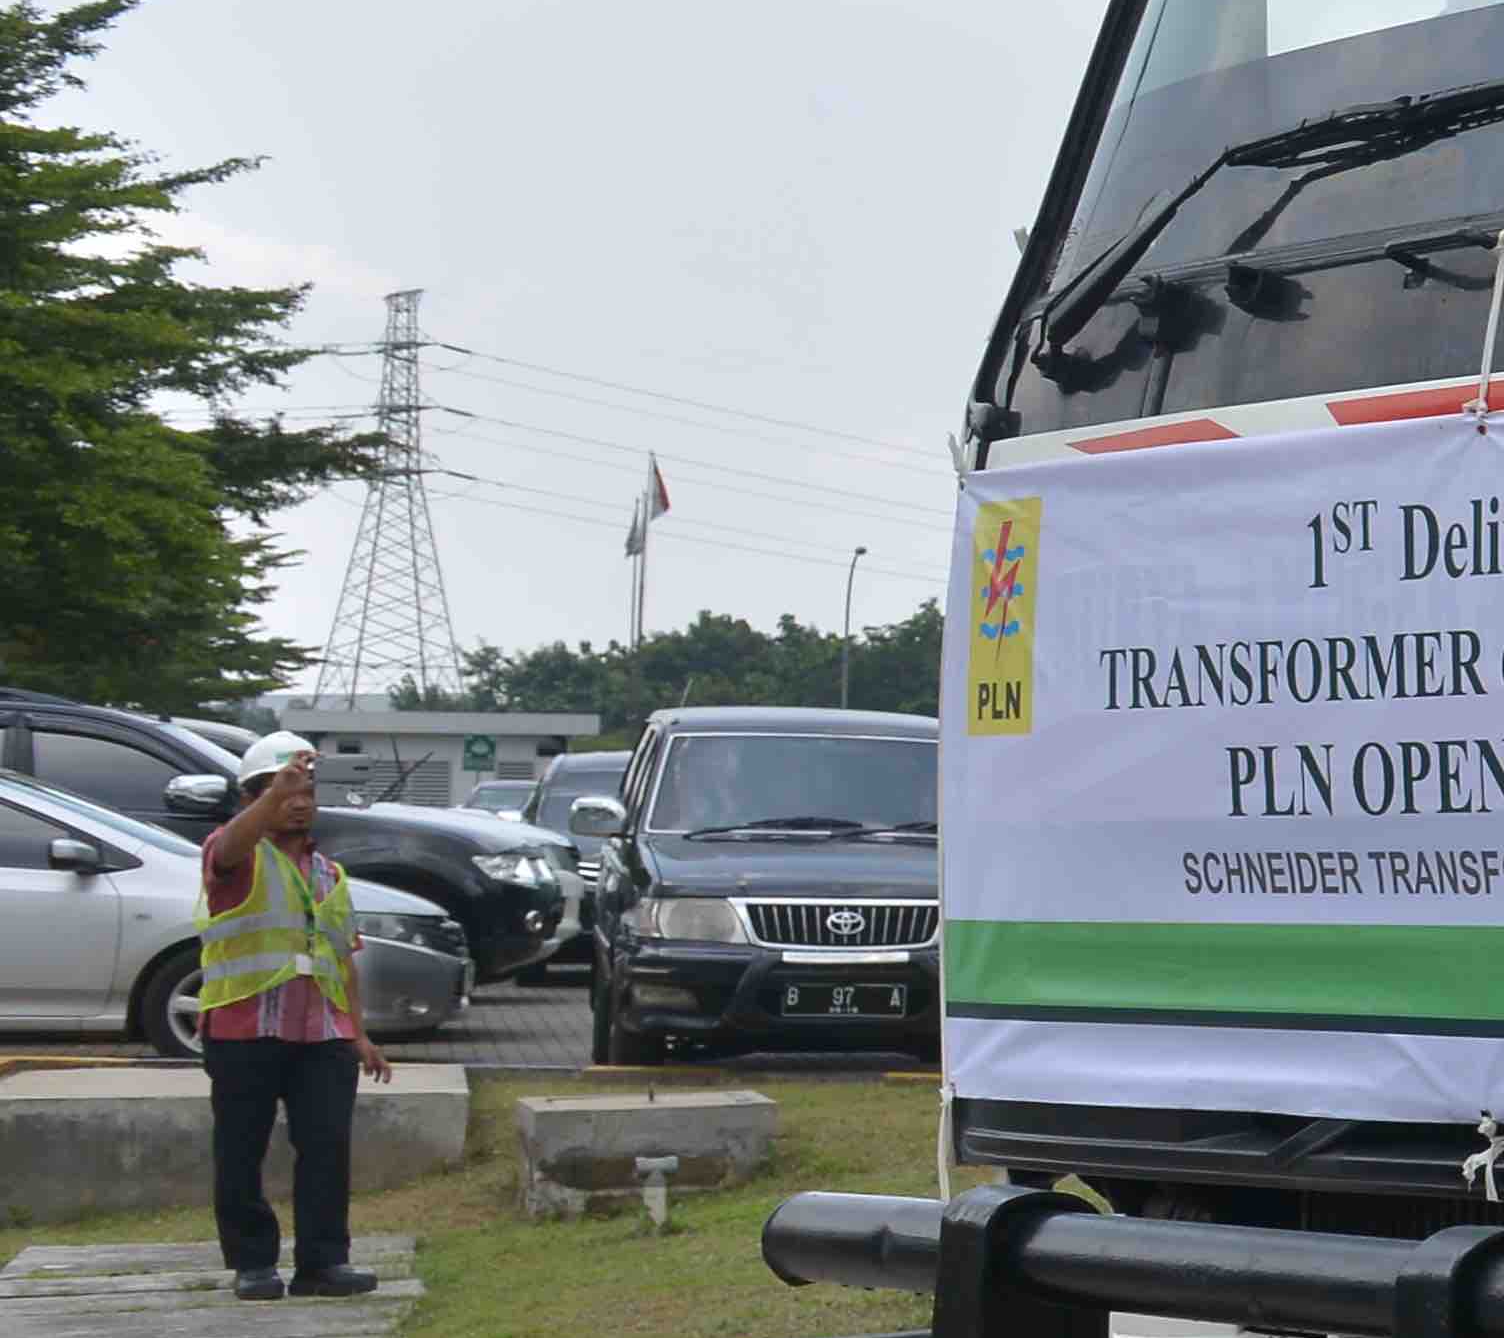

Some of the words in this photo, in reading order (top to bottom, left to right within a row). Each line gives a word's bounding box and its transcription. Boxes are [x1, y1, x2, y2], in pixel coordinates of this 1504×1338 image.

[1308, 499, 1378, 589] 1ST
[1100, 630, 1485, 710] TRANSFORMER
[976, 680, 1023, 721] PLN
[1225, 743, 1335, 818] PLN
[1183, 851, 1361, 895] SCHNEIDER
[786, 986, 799, 1006] B
[832, 986, 855, 1006] 97
[889, 987, 901, 1007] A
